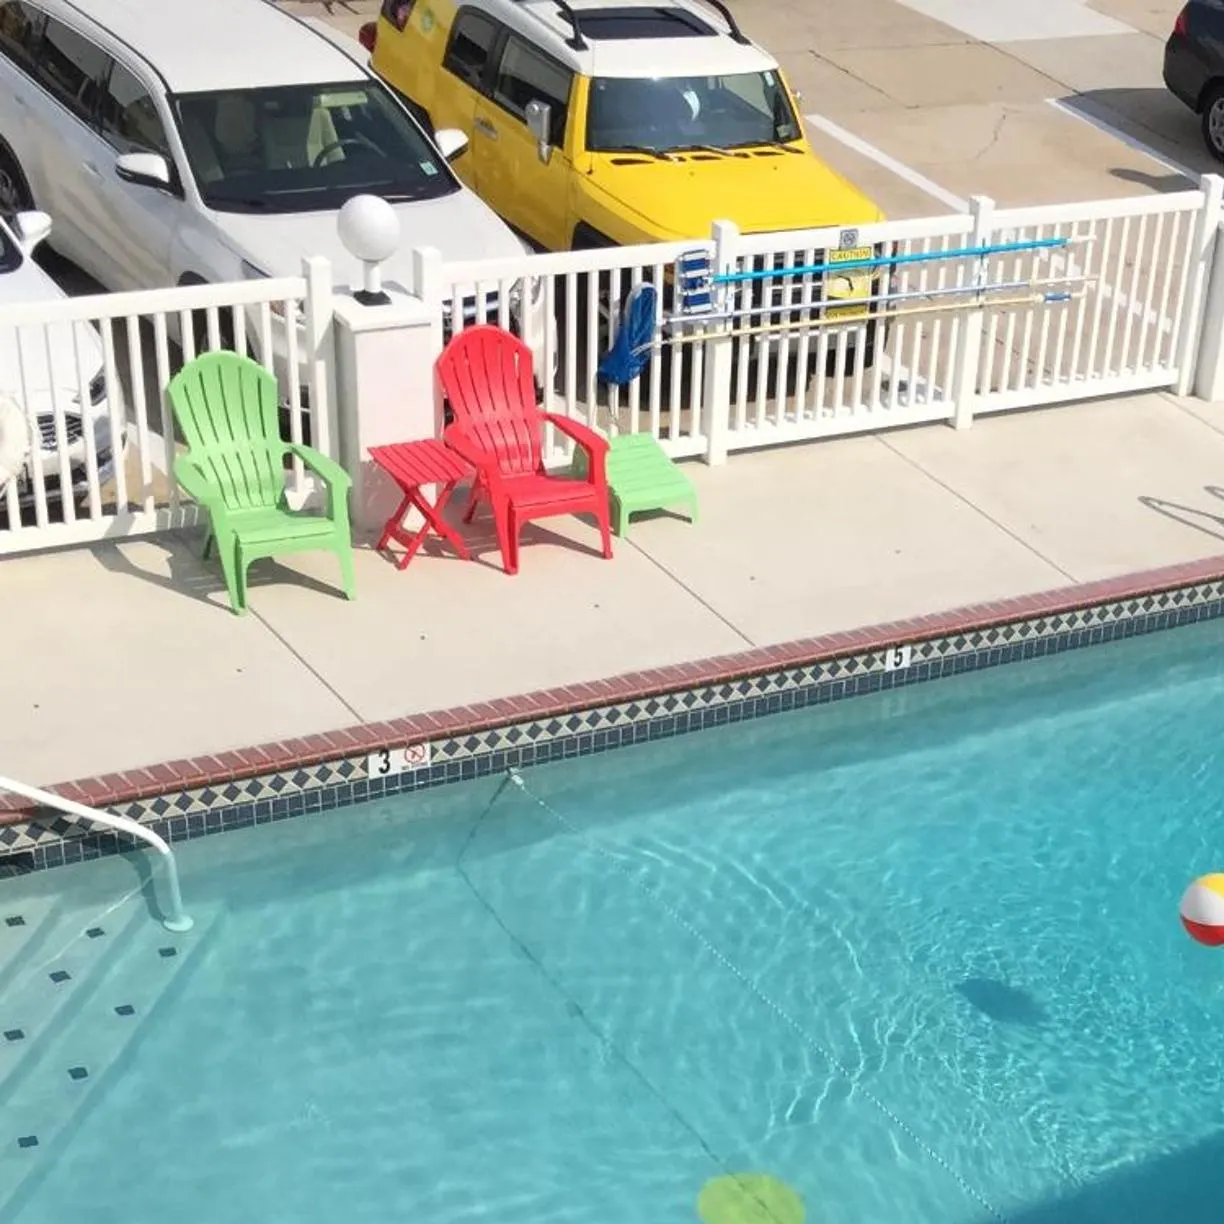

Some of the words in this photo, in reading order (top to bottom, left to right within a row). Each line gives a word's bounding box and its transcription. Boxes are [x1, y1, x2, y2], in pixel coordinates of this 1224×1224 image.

[831, 249, 871, 260] CAUTION
[894, 645, 904, 667] 5
[378, 749, 391, 774] 3
